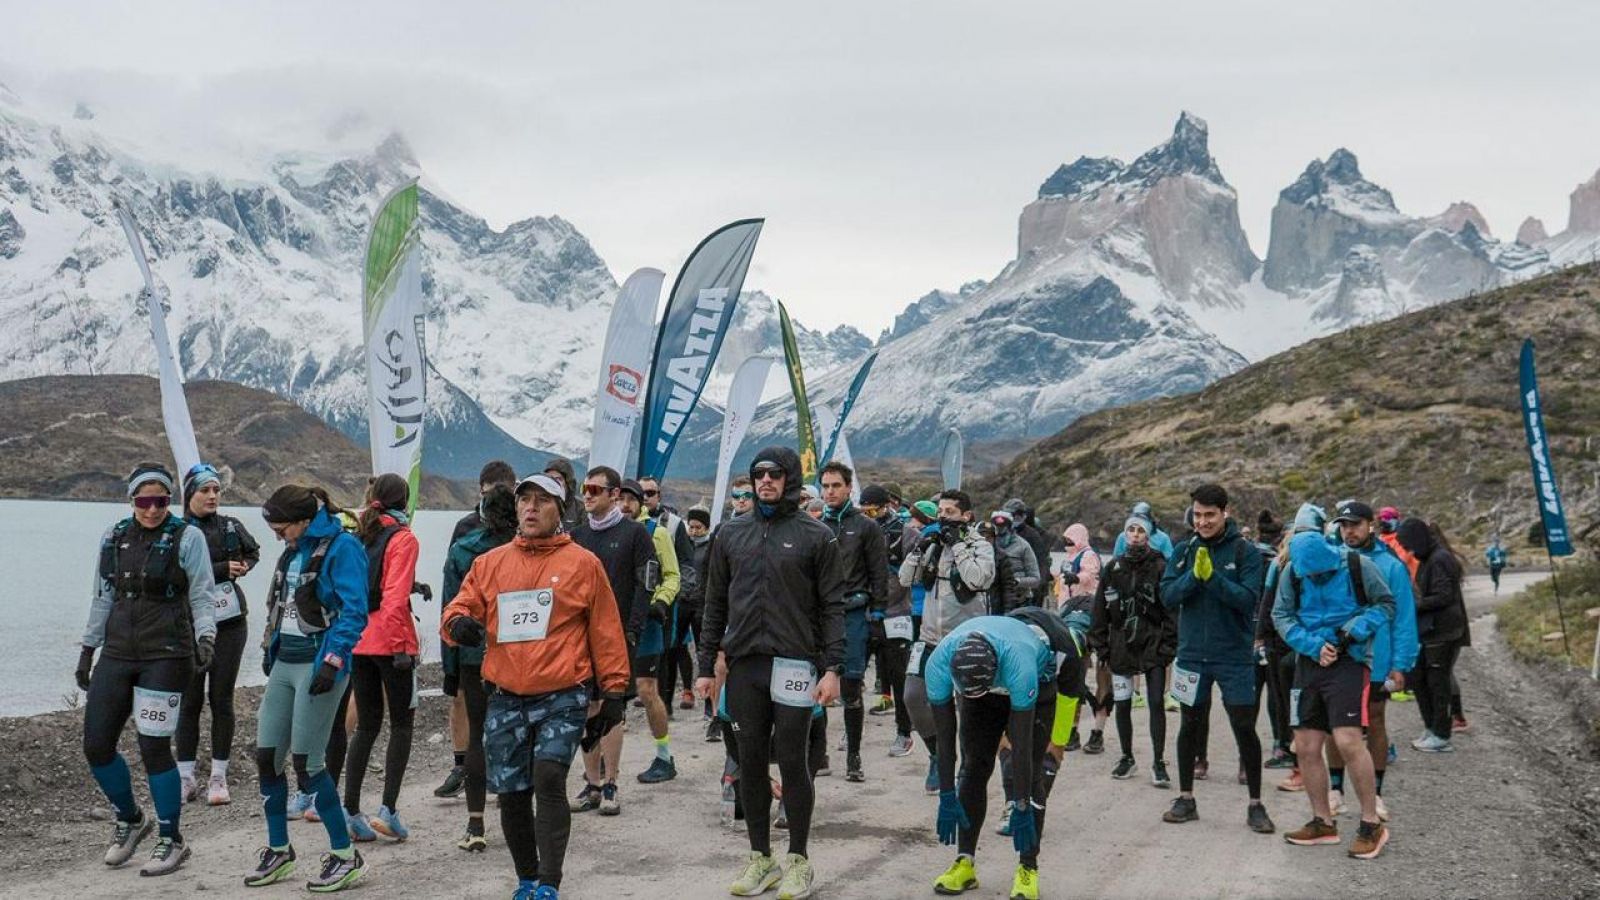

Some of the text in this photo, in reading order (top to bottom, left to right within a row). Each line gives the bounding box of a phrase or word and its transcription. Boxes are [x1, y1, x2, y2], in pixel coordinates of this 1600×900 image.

[656, 287, 730, 453] LAVAZZA
[512, 611, 539, 625] 273
[784, 679, 810, 692] 287
[140, 709, 167, 722] 285
